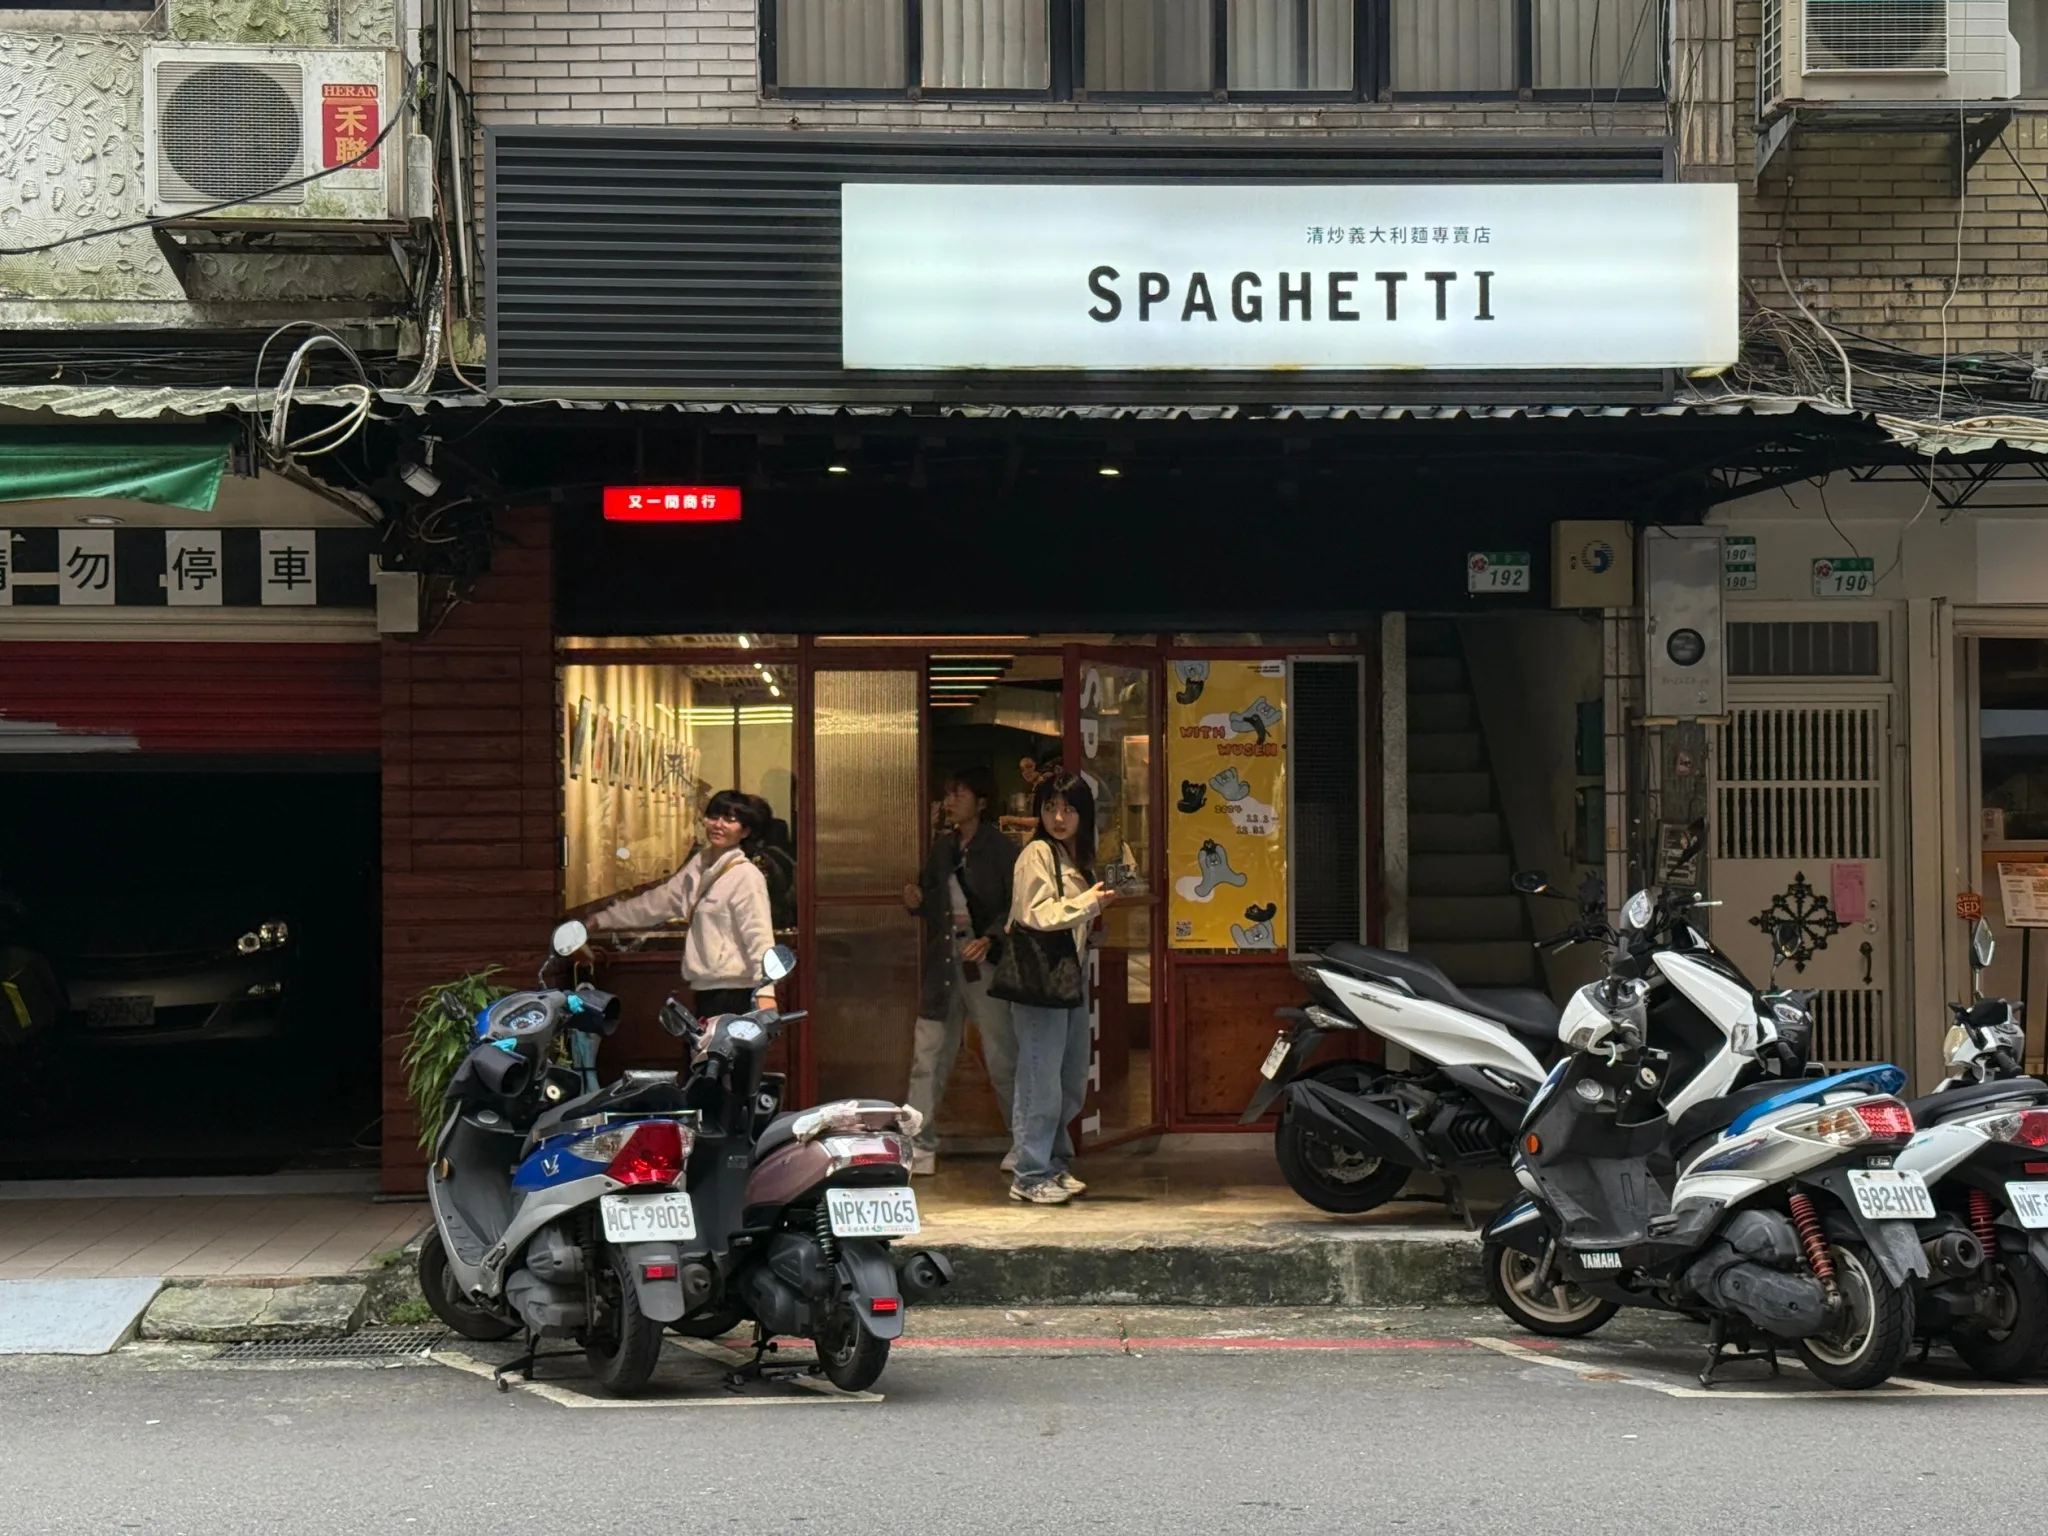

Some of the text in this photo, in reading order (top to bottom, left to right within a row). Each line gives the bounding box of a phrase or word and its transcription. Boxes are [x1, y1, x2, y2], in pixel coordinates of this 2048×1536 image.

[324, 85, 377, 97] HERAN
[334, 105, 368, 167] 禾聯
[1306, 226, 1491, 245] 清炒義大利麵專賣店
[1088, 265, 1495, 323] SPAGHETTI
[628, 494, 716, 509] 又一間商行
[1726, 549, 1747, 561] 190
[1490, 569, 1523, 586] 192
[1726, 576, 1747, 588] 190
[1835, 575, 1867, 592] 190
[1179, 726, 1226, 739] WITH
[1217, 743, 1278, 757] WUSEN
[1857, 1186, 1927, 1212] 982-HYP
[1579, 1252, 1623, 1269] YAMAHA
